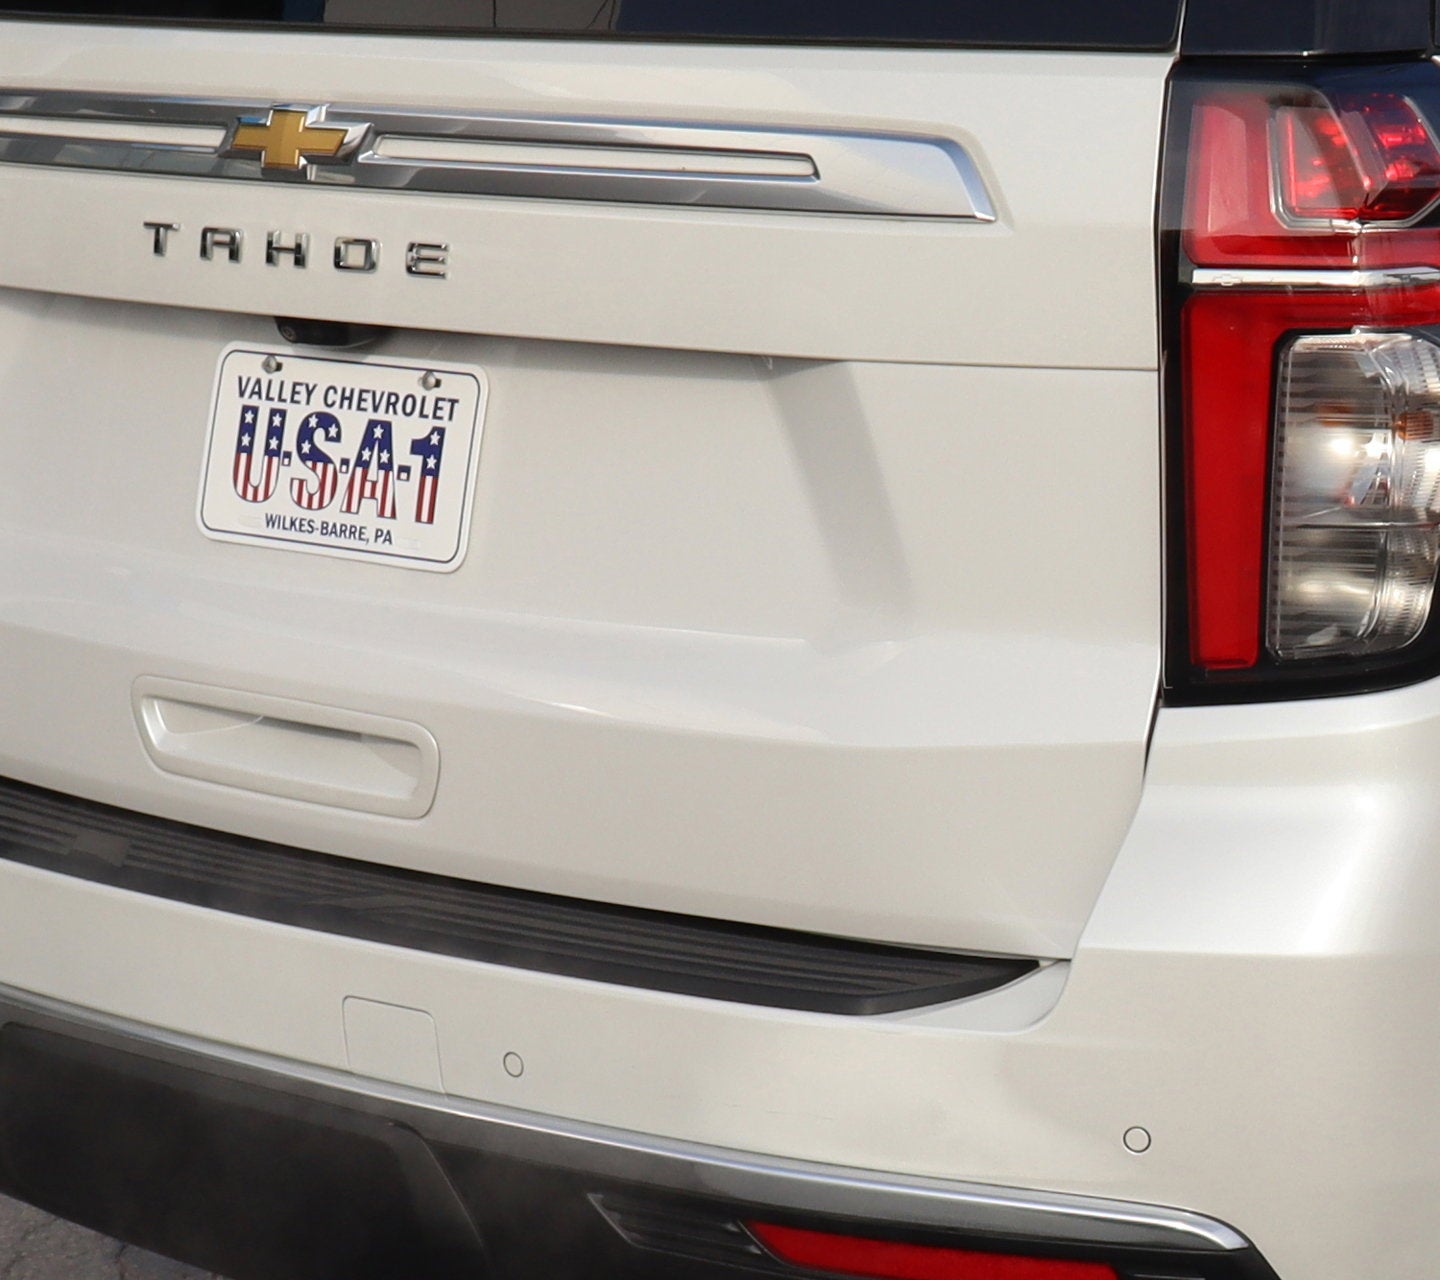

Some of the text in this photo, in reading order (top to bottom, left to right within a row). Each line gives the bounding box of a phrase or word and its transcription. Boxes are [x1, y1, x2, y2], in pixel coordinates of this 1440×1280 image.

[143, 221, 449, 280] TAHOE
[237, 375, 459, 422] VALLEY CHEVROLET
[264, 512, 393, 545] WILKES-BARRE, PA
